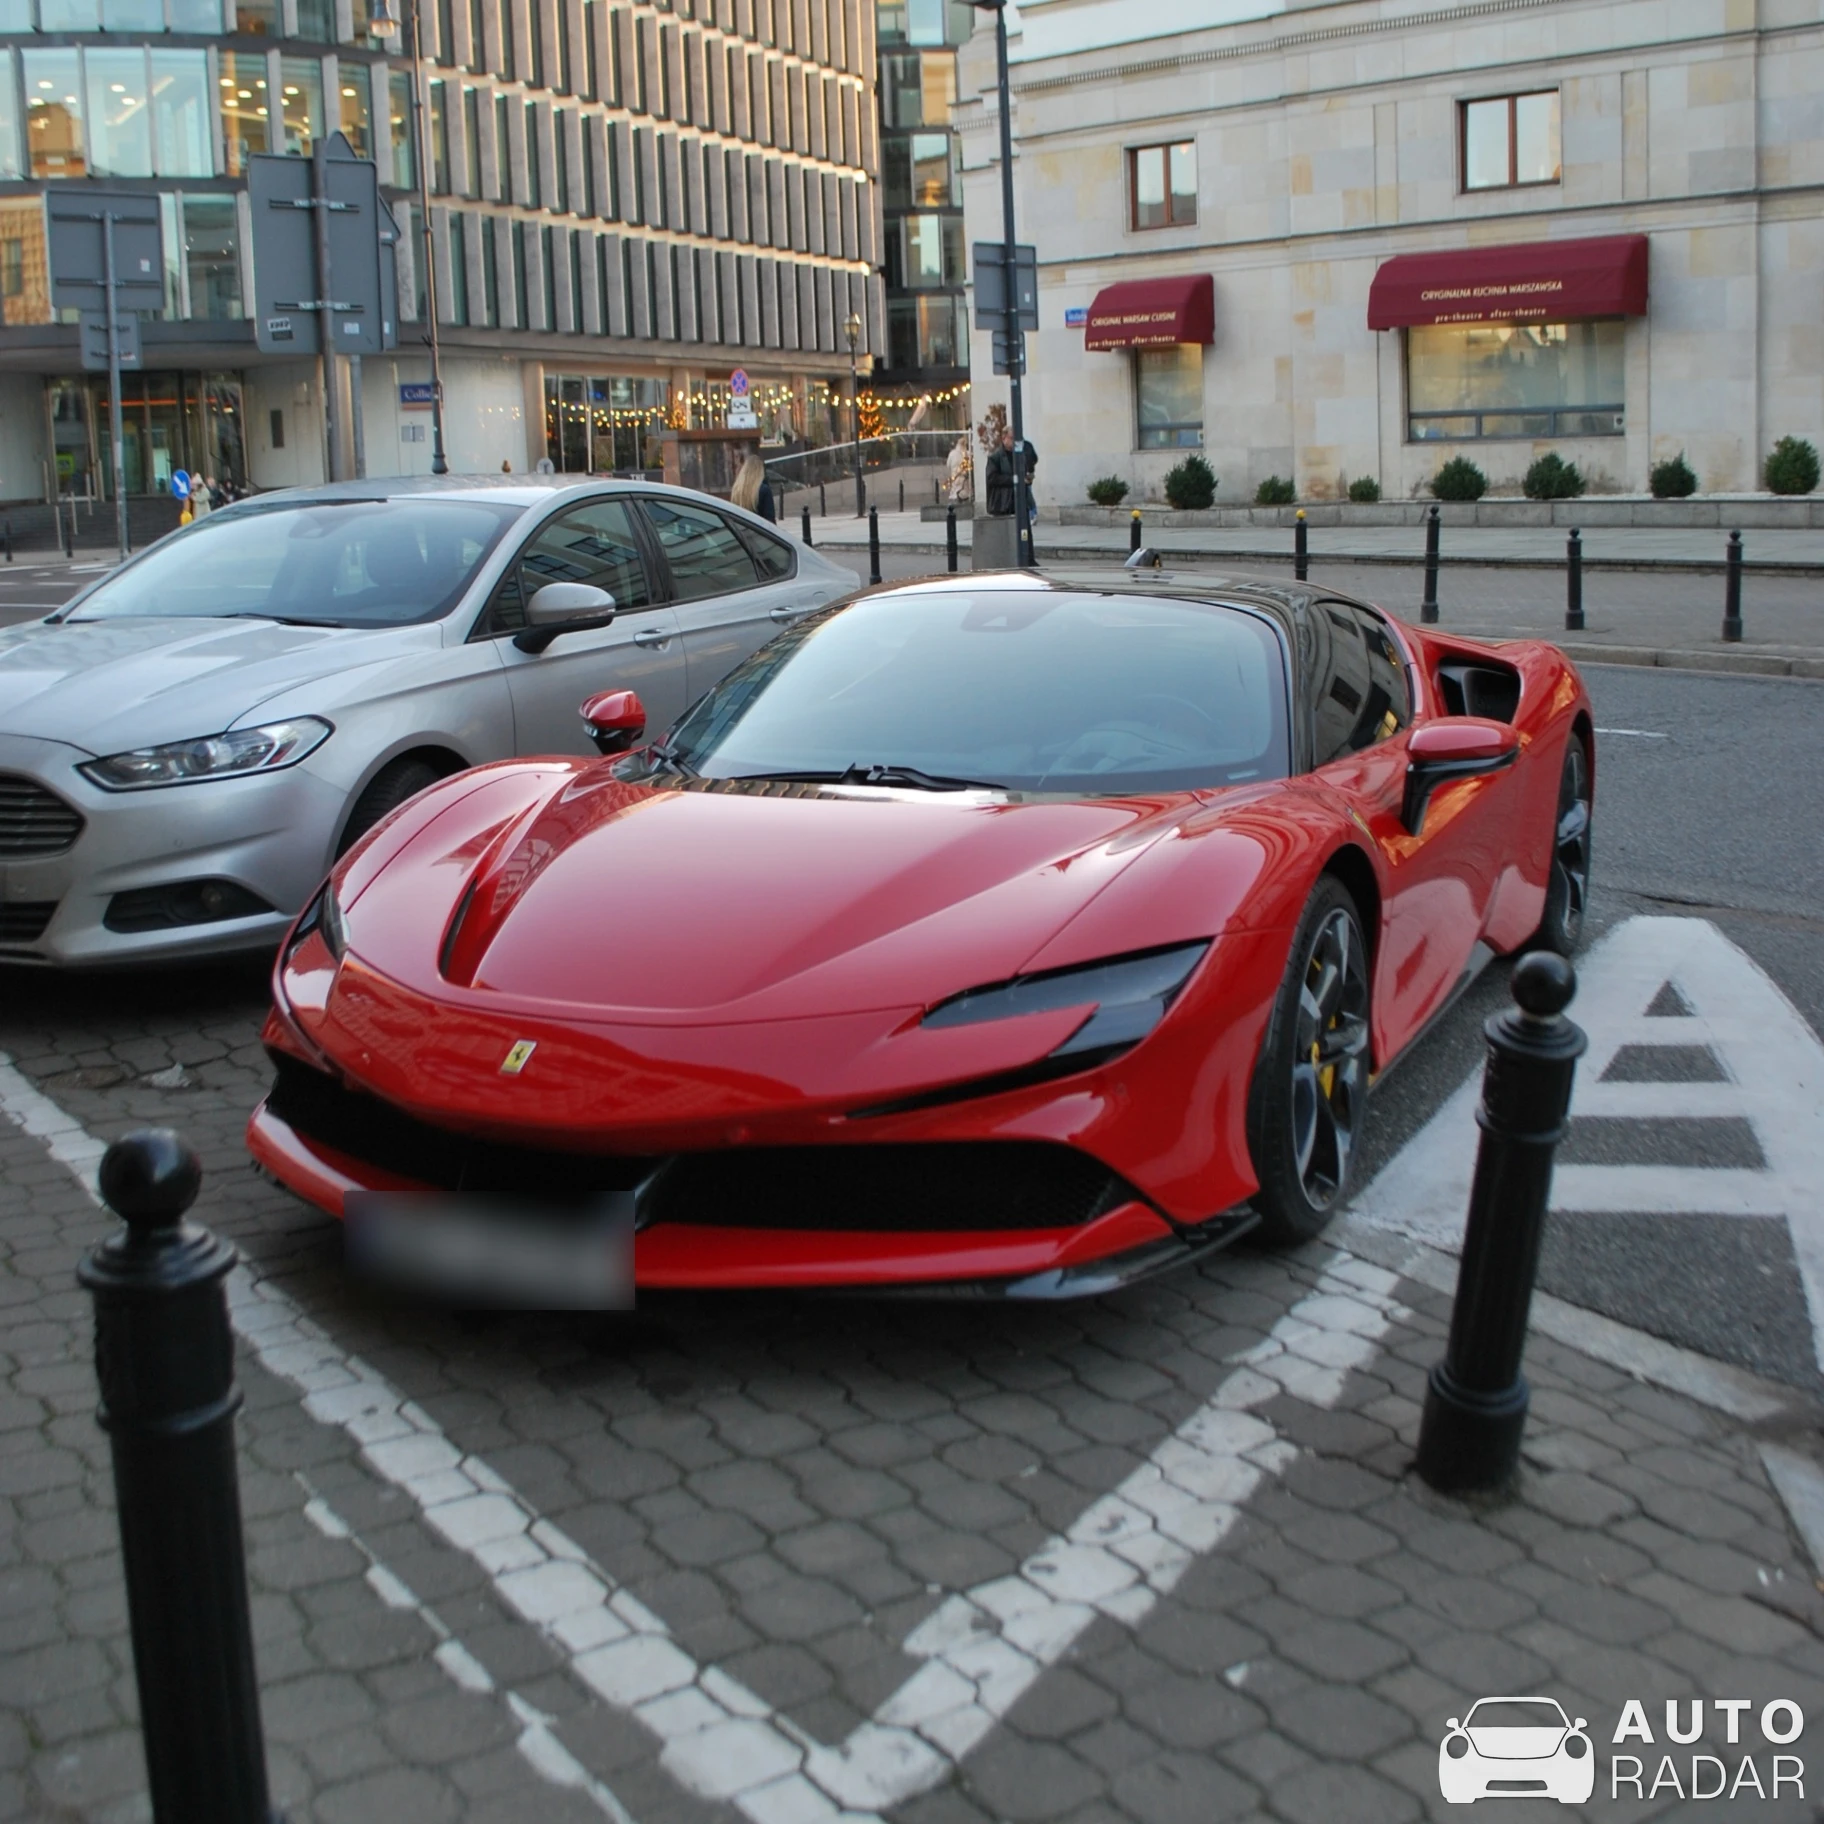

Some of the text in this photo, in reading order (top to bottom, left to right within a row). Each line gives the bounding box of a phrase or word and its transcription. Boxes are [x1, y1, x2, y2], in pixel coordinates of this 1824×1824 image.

[1421, 281, 1562, 300] ORYGINALNA KUCHNIA WARSZAWSKA
[1091, 316, 1121, 327] ORIGINAL
[1123, 314, 1150, 324] WARSAW
[1151, 311, 1176, 322] CUISINE
[1435, 308, 1546, 323] pre-theatre after-theatre
